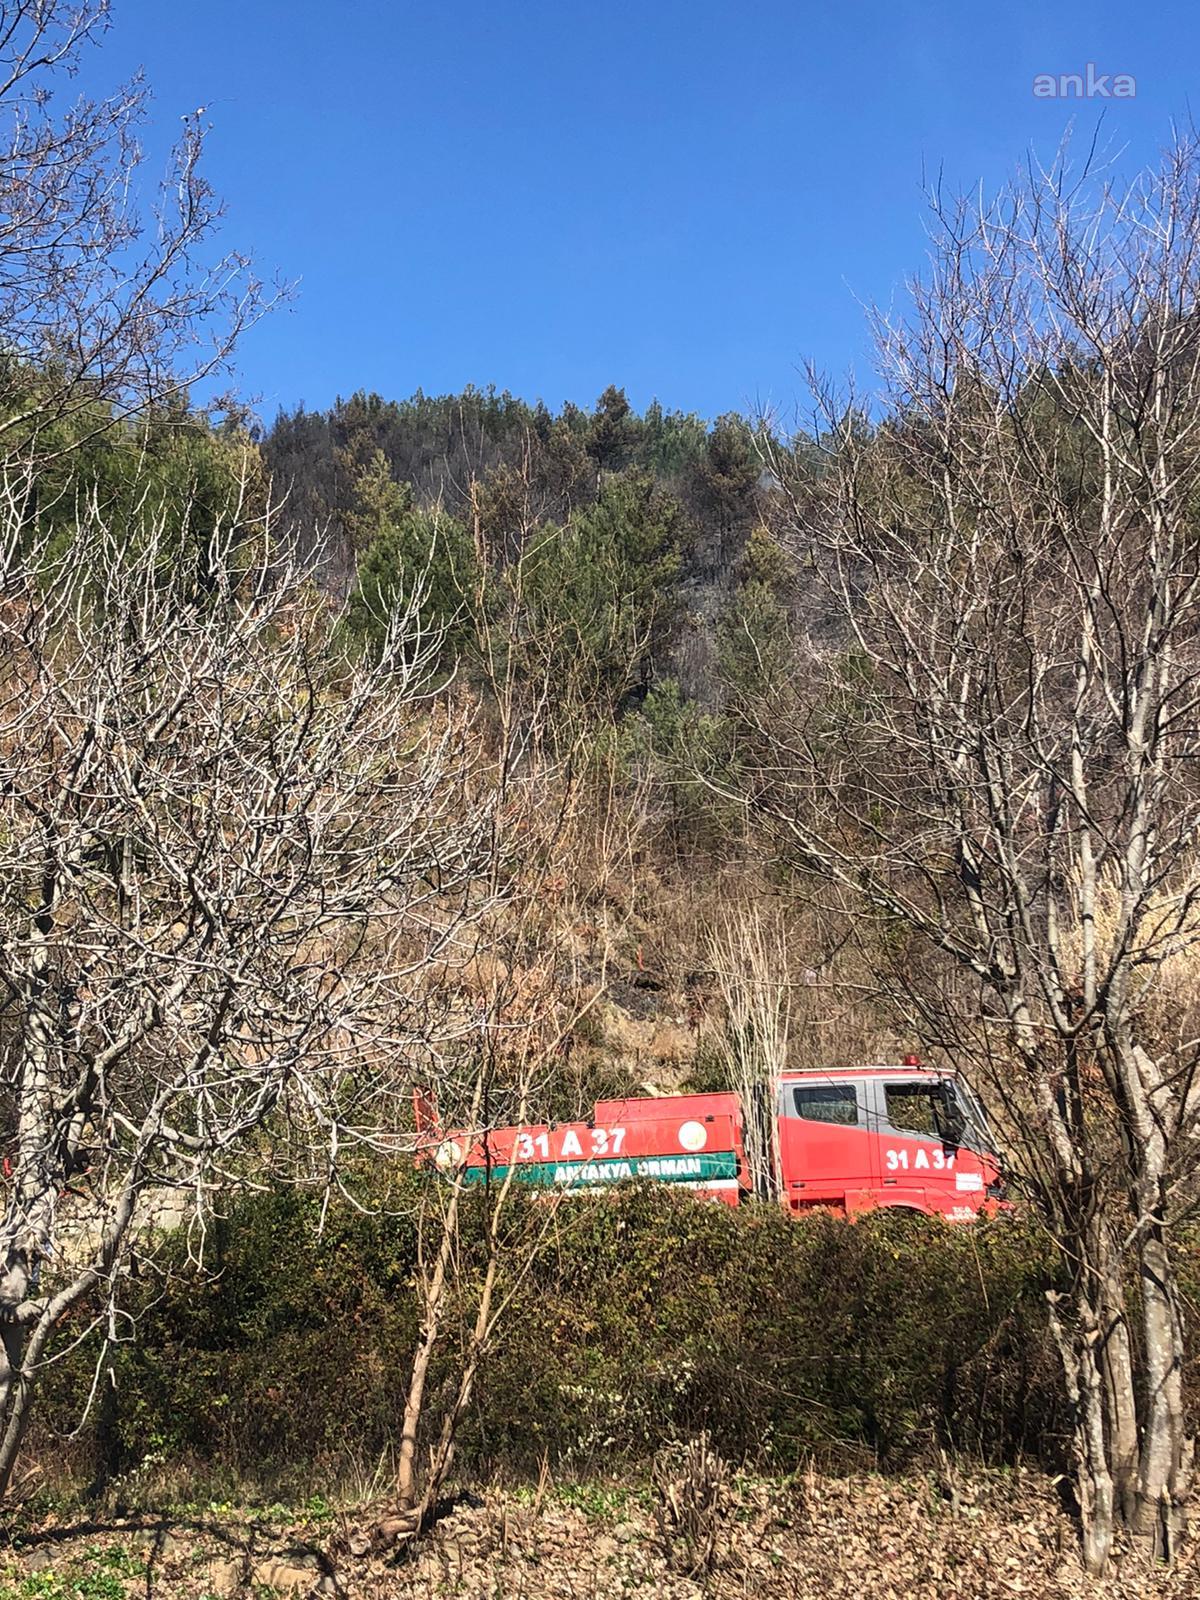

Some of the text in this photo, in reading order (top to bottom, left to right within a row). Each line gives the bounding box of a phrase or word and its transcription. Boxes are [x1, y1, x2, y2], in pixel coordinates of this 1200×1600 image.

[519, 1127, 626, 1159] 31 A 37
[886, 1149, 909, 1170] 31
[915, 1148, 930, 1169] A
[554, 1162, 632, 1182] ANTAKYA
